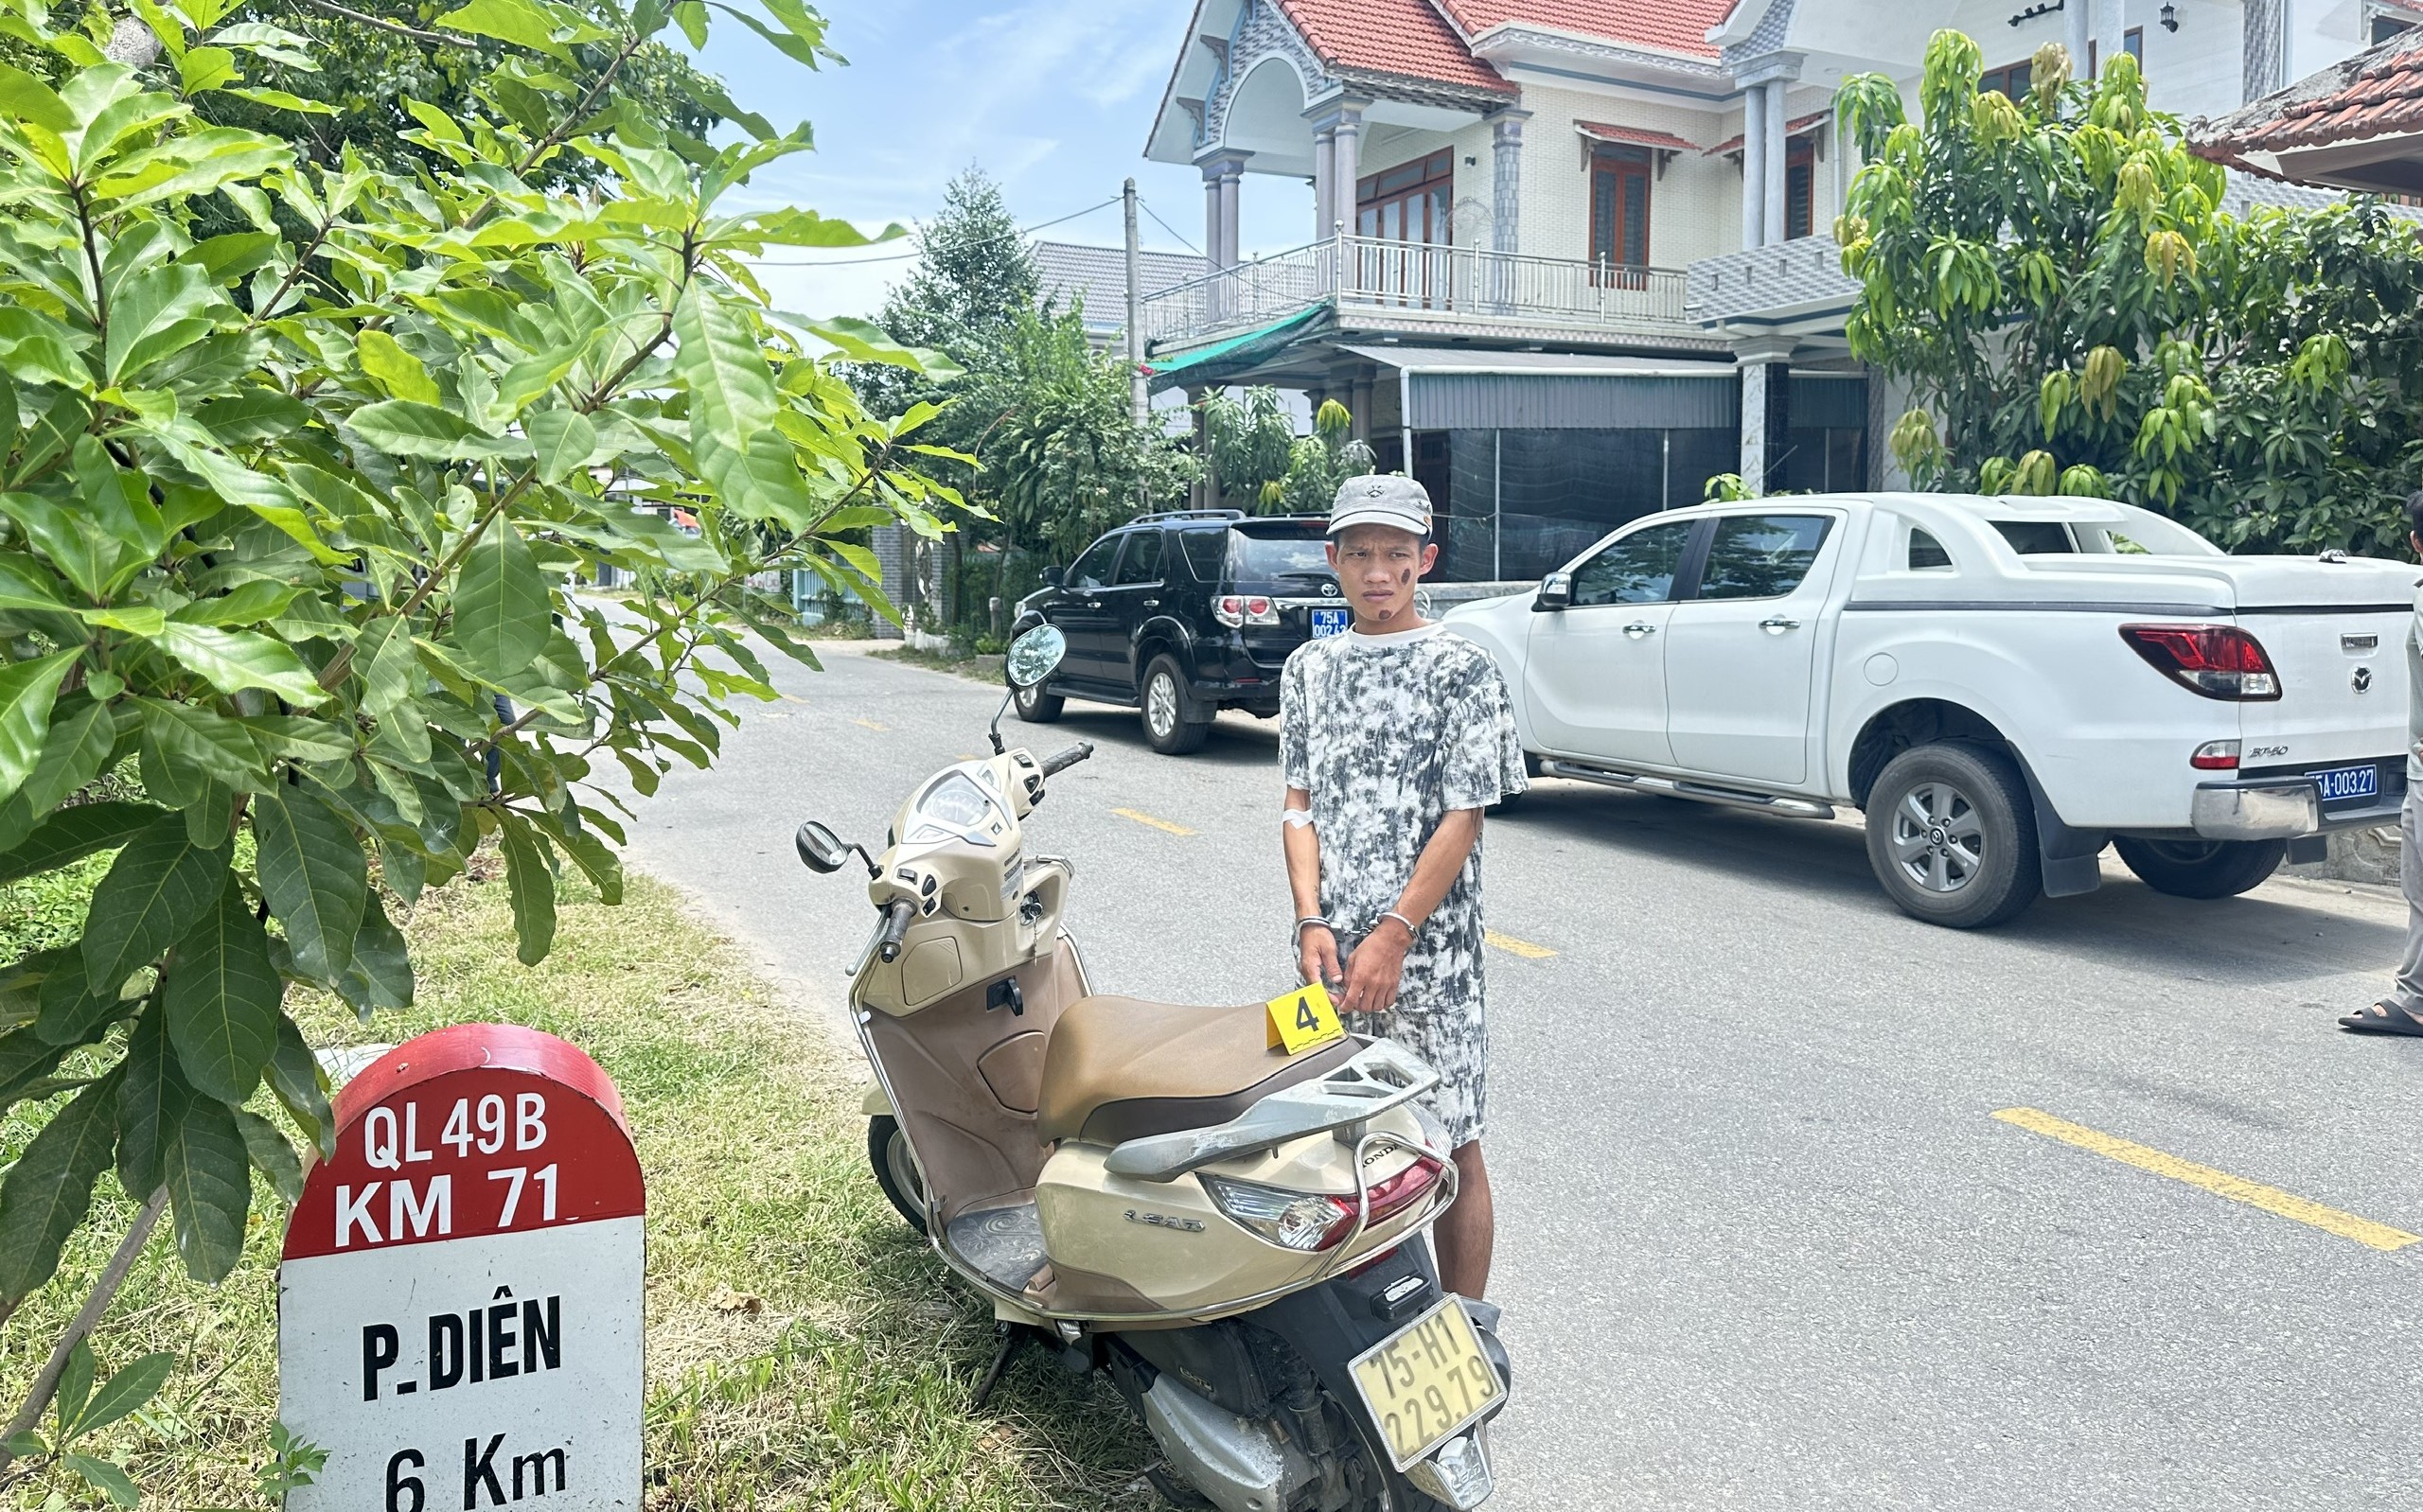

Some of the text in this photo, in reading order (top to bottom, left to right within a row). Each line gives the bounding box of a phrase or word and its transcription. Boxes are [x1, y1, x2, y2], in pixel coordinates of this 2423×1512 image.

[1320, 611, 1339, 624] 75A
[1296, 996, 1319, 1032] 4
[1363, 1143, 1403, 1168] ONDA
[335, 1163, 557, 1248] KM 71
[1368, 1311, 1460, 1399] 75-H1
[1384, 1355, 1494, 1464] 229.79
[385, 1433, 566, 1512] 6 Km
